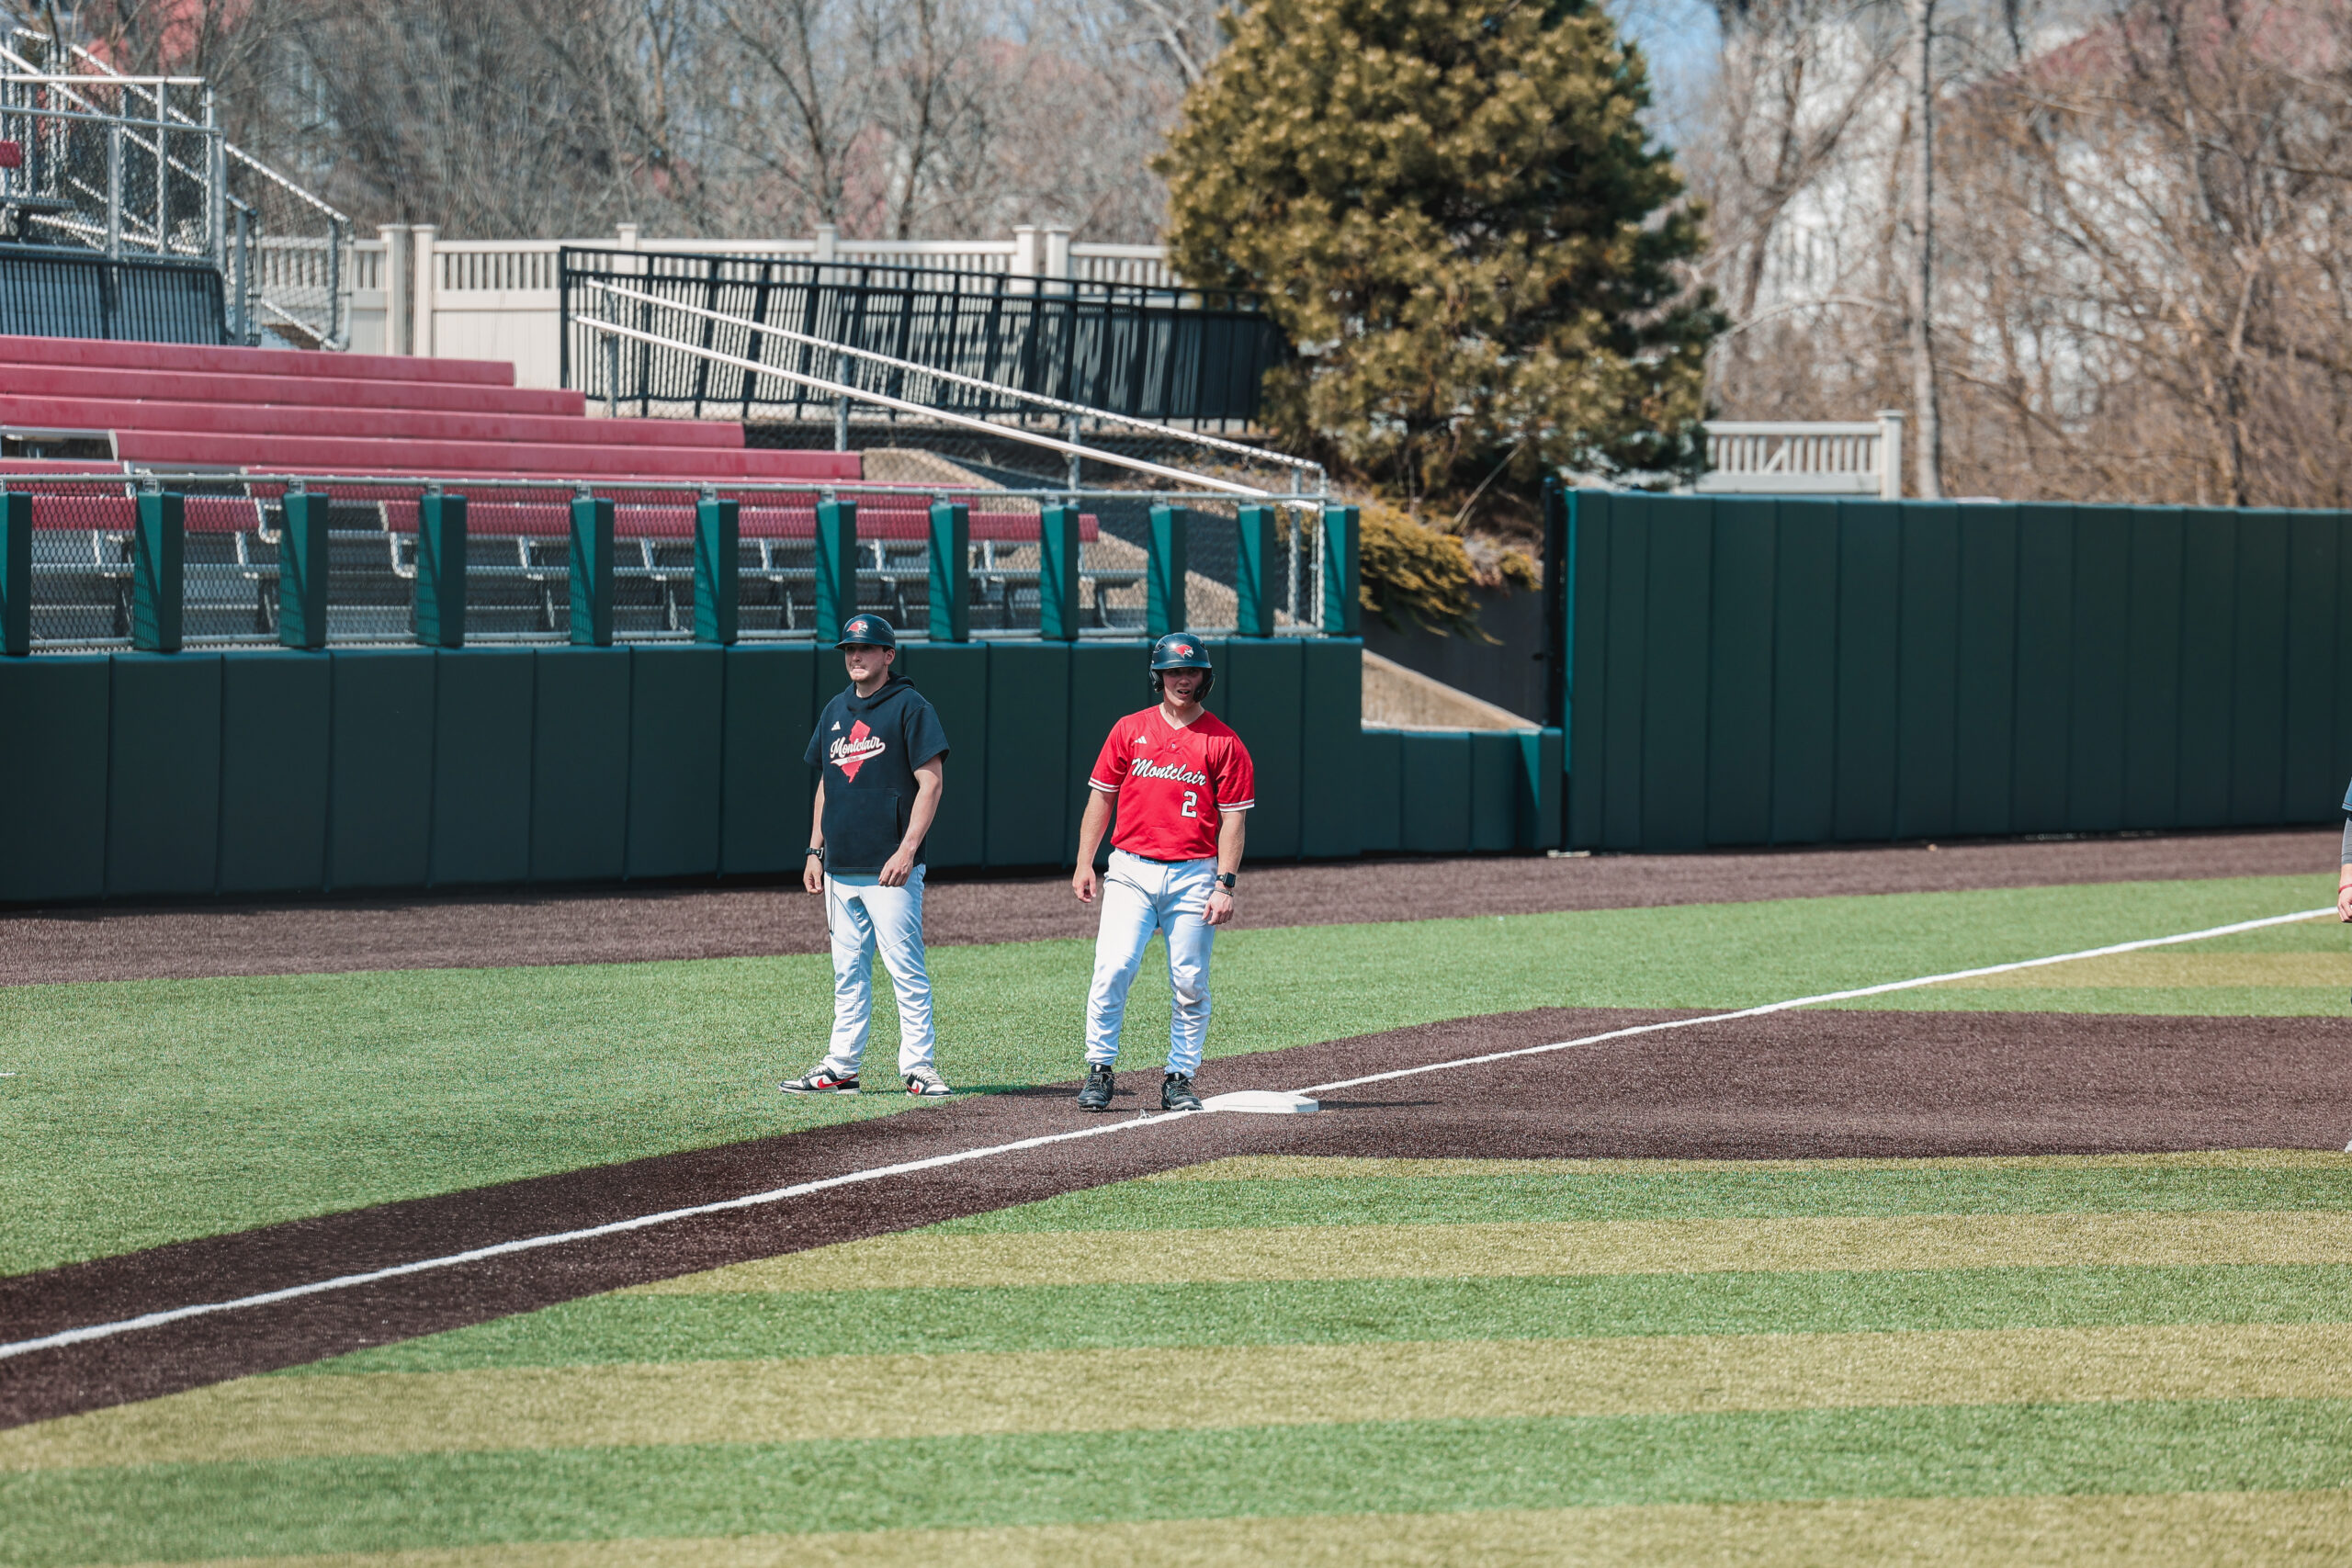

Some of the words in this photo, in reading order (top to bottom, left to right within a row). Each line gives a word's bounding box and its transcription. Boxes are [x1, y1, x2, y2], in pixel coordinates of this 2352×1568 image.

[830, 736, 883, 759] Montclair
[1131, 758, 1206, 786] Montclair
[1181, 790, 1198, 818] 2
